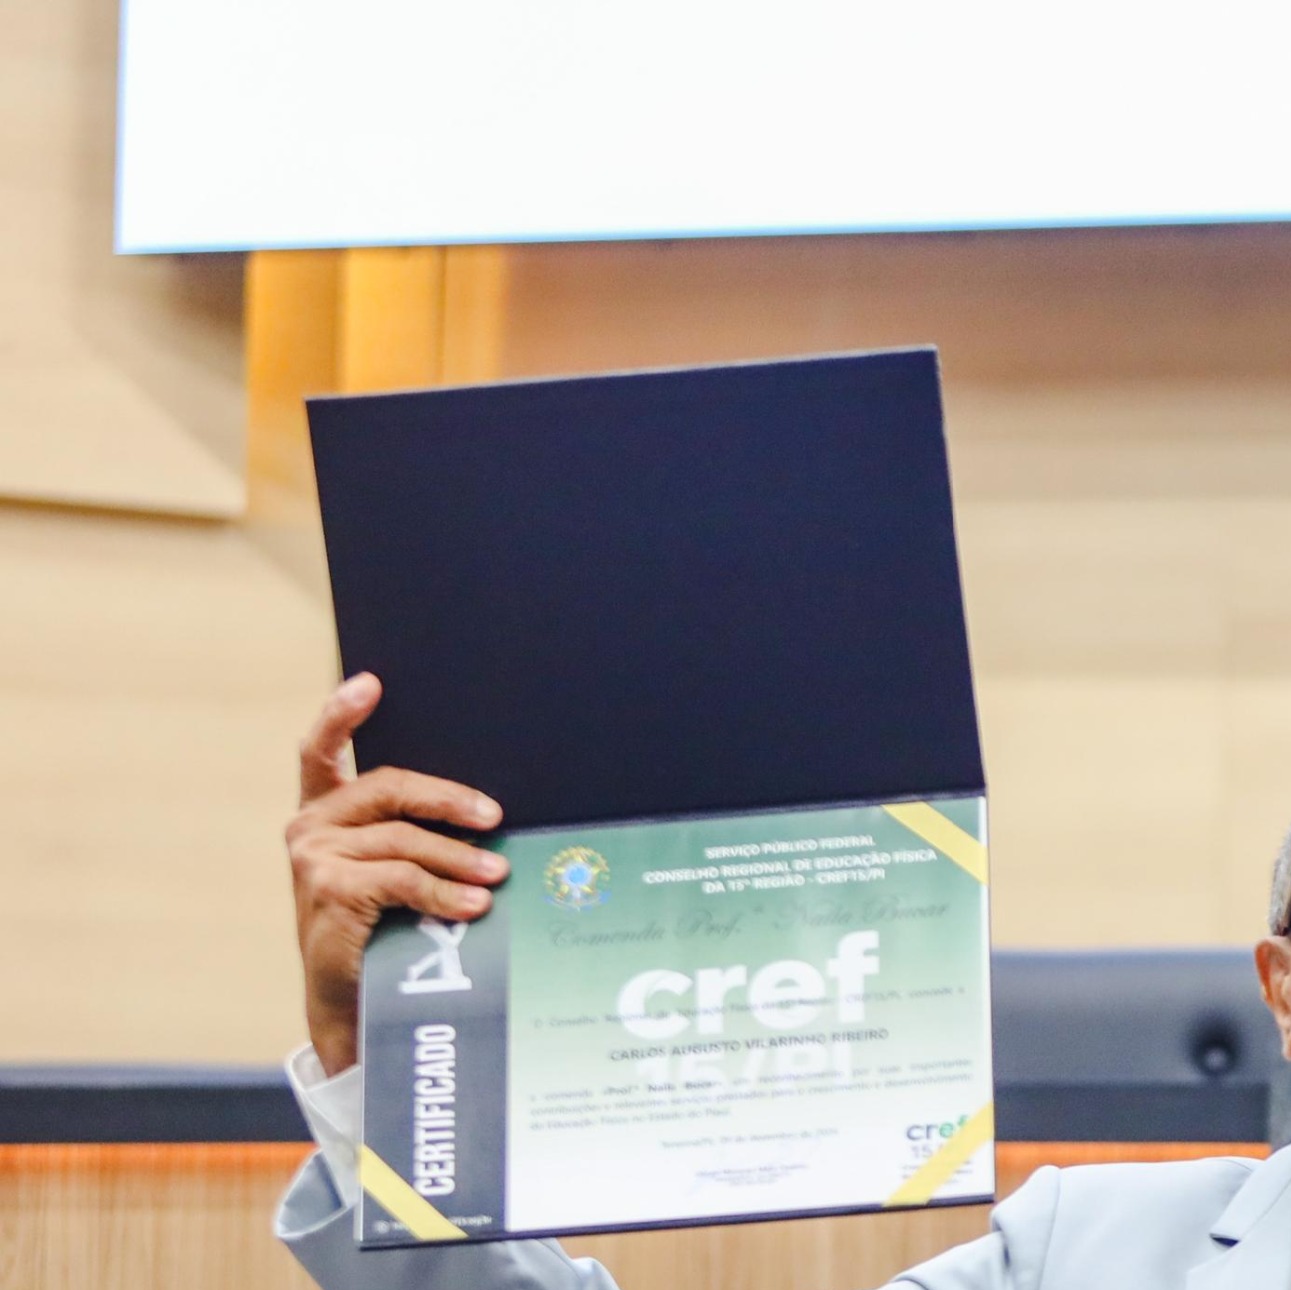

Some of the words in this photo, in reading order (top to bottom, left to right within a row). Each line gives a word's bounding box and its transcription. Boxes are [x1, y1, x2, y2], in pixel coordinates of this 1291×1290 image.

[704, 843, 761, 860] SERVIÇO
[760, 837, 818, 854] PÚBLICO
[818, 834, 876, 850] FEDERAL
[642, 865, 720, 884] CONSELHO
[719, 860, 791, 877] REGIONAL
[791, 858, 813, 872] DE
[813, 850, 892, 870] EDUCAÇÃO
[891, 848, 938, 864] FÍSICA
[702, 880, 726, 894] DA
[751, 870, 806, 890] REGIÃO
[616, 929, 881, 1041] cref
[609, 1045, 667, 1062] CARLOS
[671, 1039, 741, 1057] AUGUSTO
[745, 1032, 827, 1050] VILARINHO
[831, 1027, 889, 1043] RIBEIRO
[412, 1024, 457, 1197] CERTIFICADO
